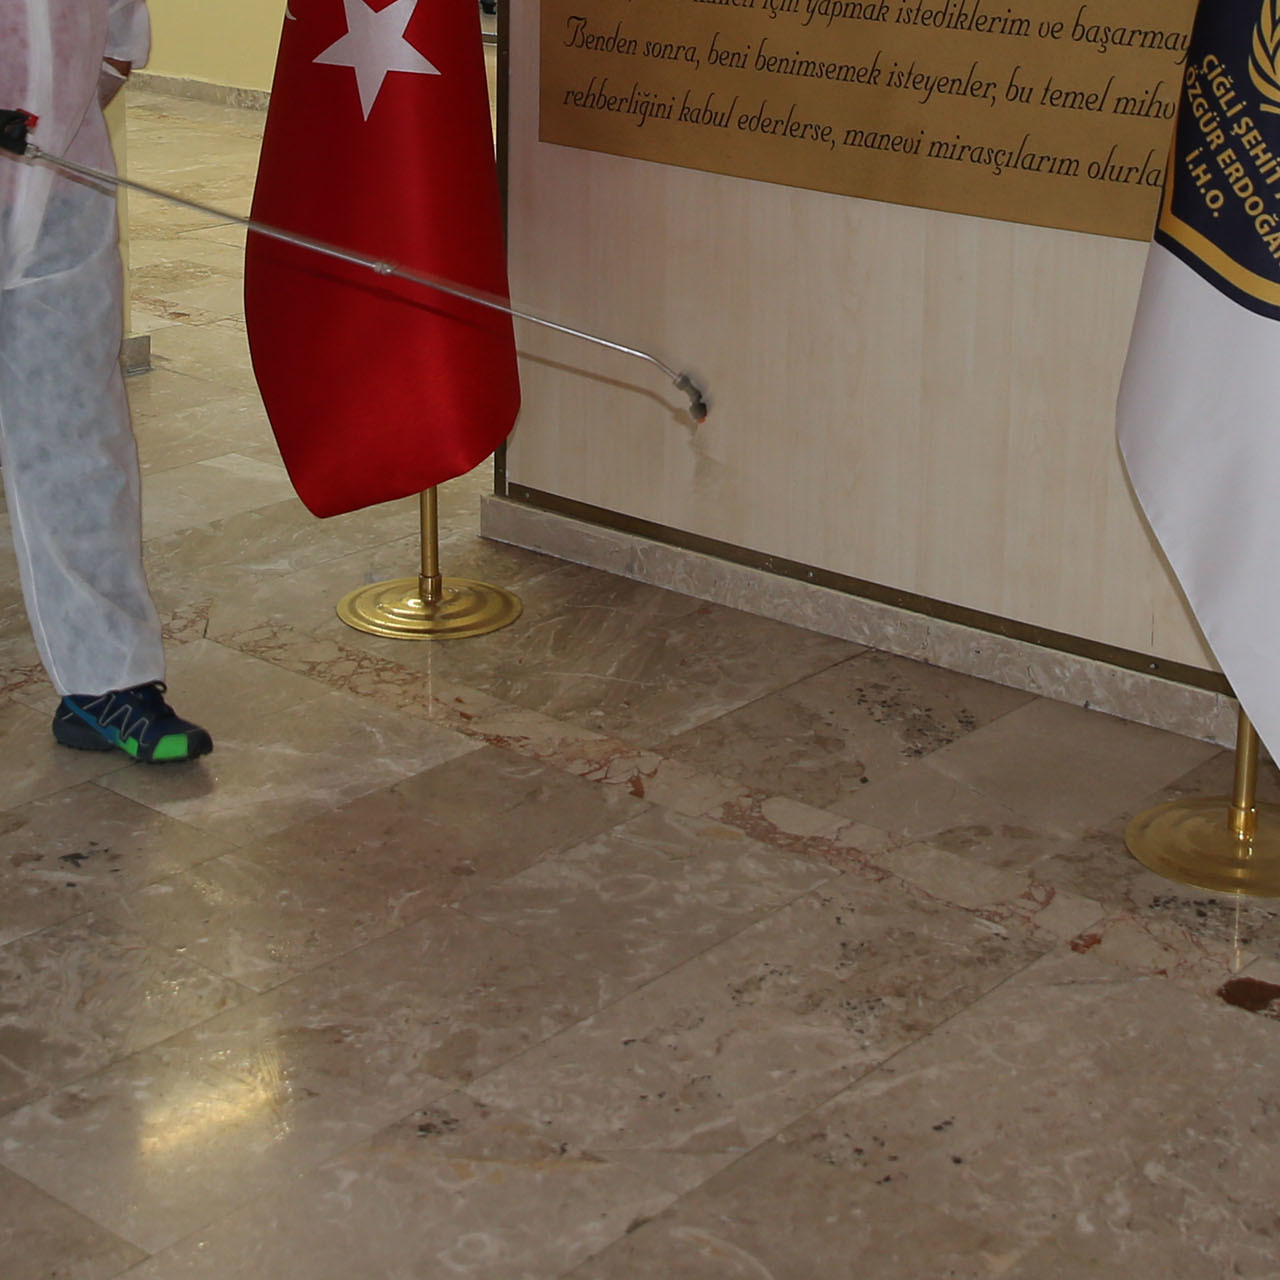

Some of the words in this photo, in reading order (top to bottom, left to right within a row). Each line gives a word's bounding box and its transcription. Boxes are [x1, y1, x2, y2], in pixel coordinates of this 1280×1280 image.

[563, 16, 638, 54] Benden
[643, 36, 700, 66] sonra,
[707, 31, 747, 70] beni
[755, 38, 881, 86] benimsemek
[886, 62, 998, 106] isteyenler,
[1004, 66, 1033, 106] bu
[1040, 76, 1118, 115] temel
[1038, 20, 1064, 41] ve
[1184, 64, 1226, 151] ÖZGÜR
[1200, 53, 1247, 118] ÇİĞLİ
[563, 76, 674, 121] rehberliğini
[678, 90, 731, 129] kabul
[736, 104, 837, 149] ederlerse,
[843, 125, 923, 156] manevi
[927, 134, 1080, 177] mirasçılarım
[1087, 145, 1163, 188] olurla
[1184, 149, 1224, 220] İ.H.O.
